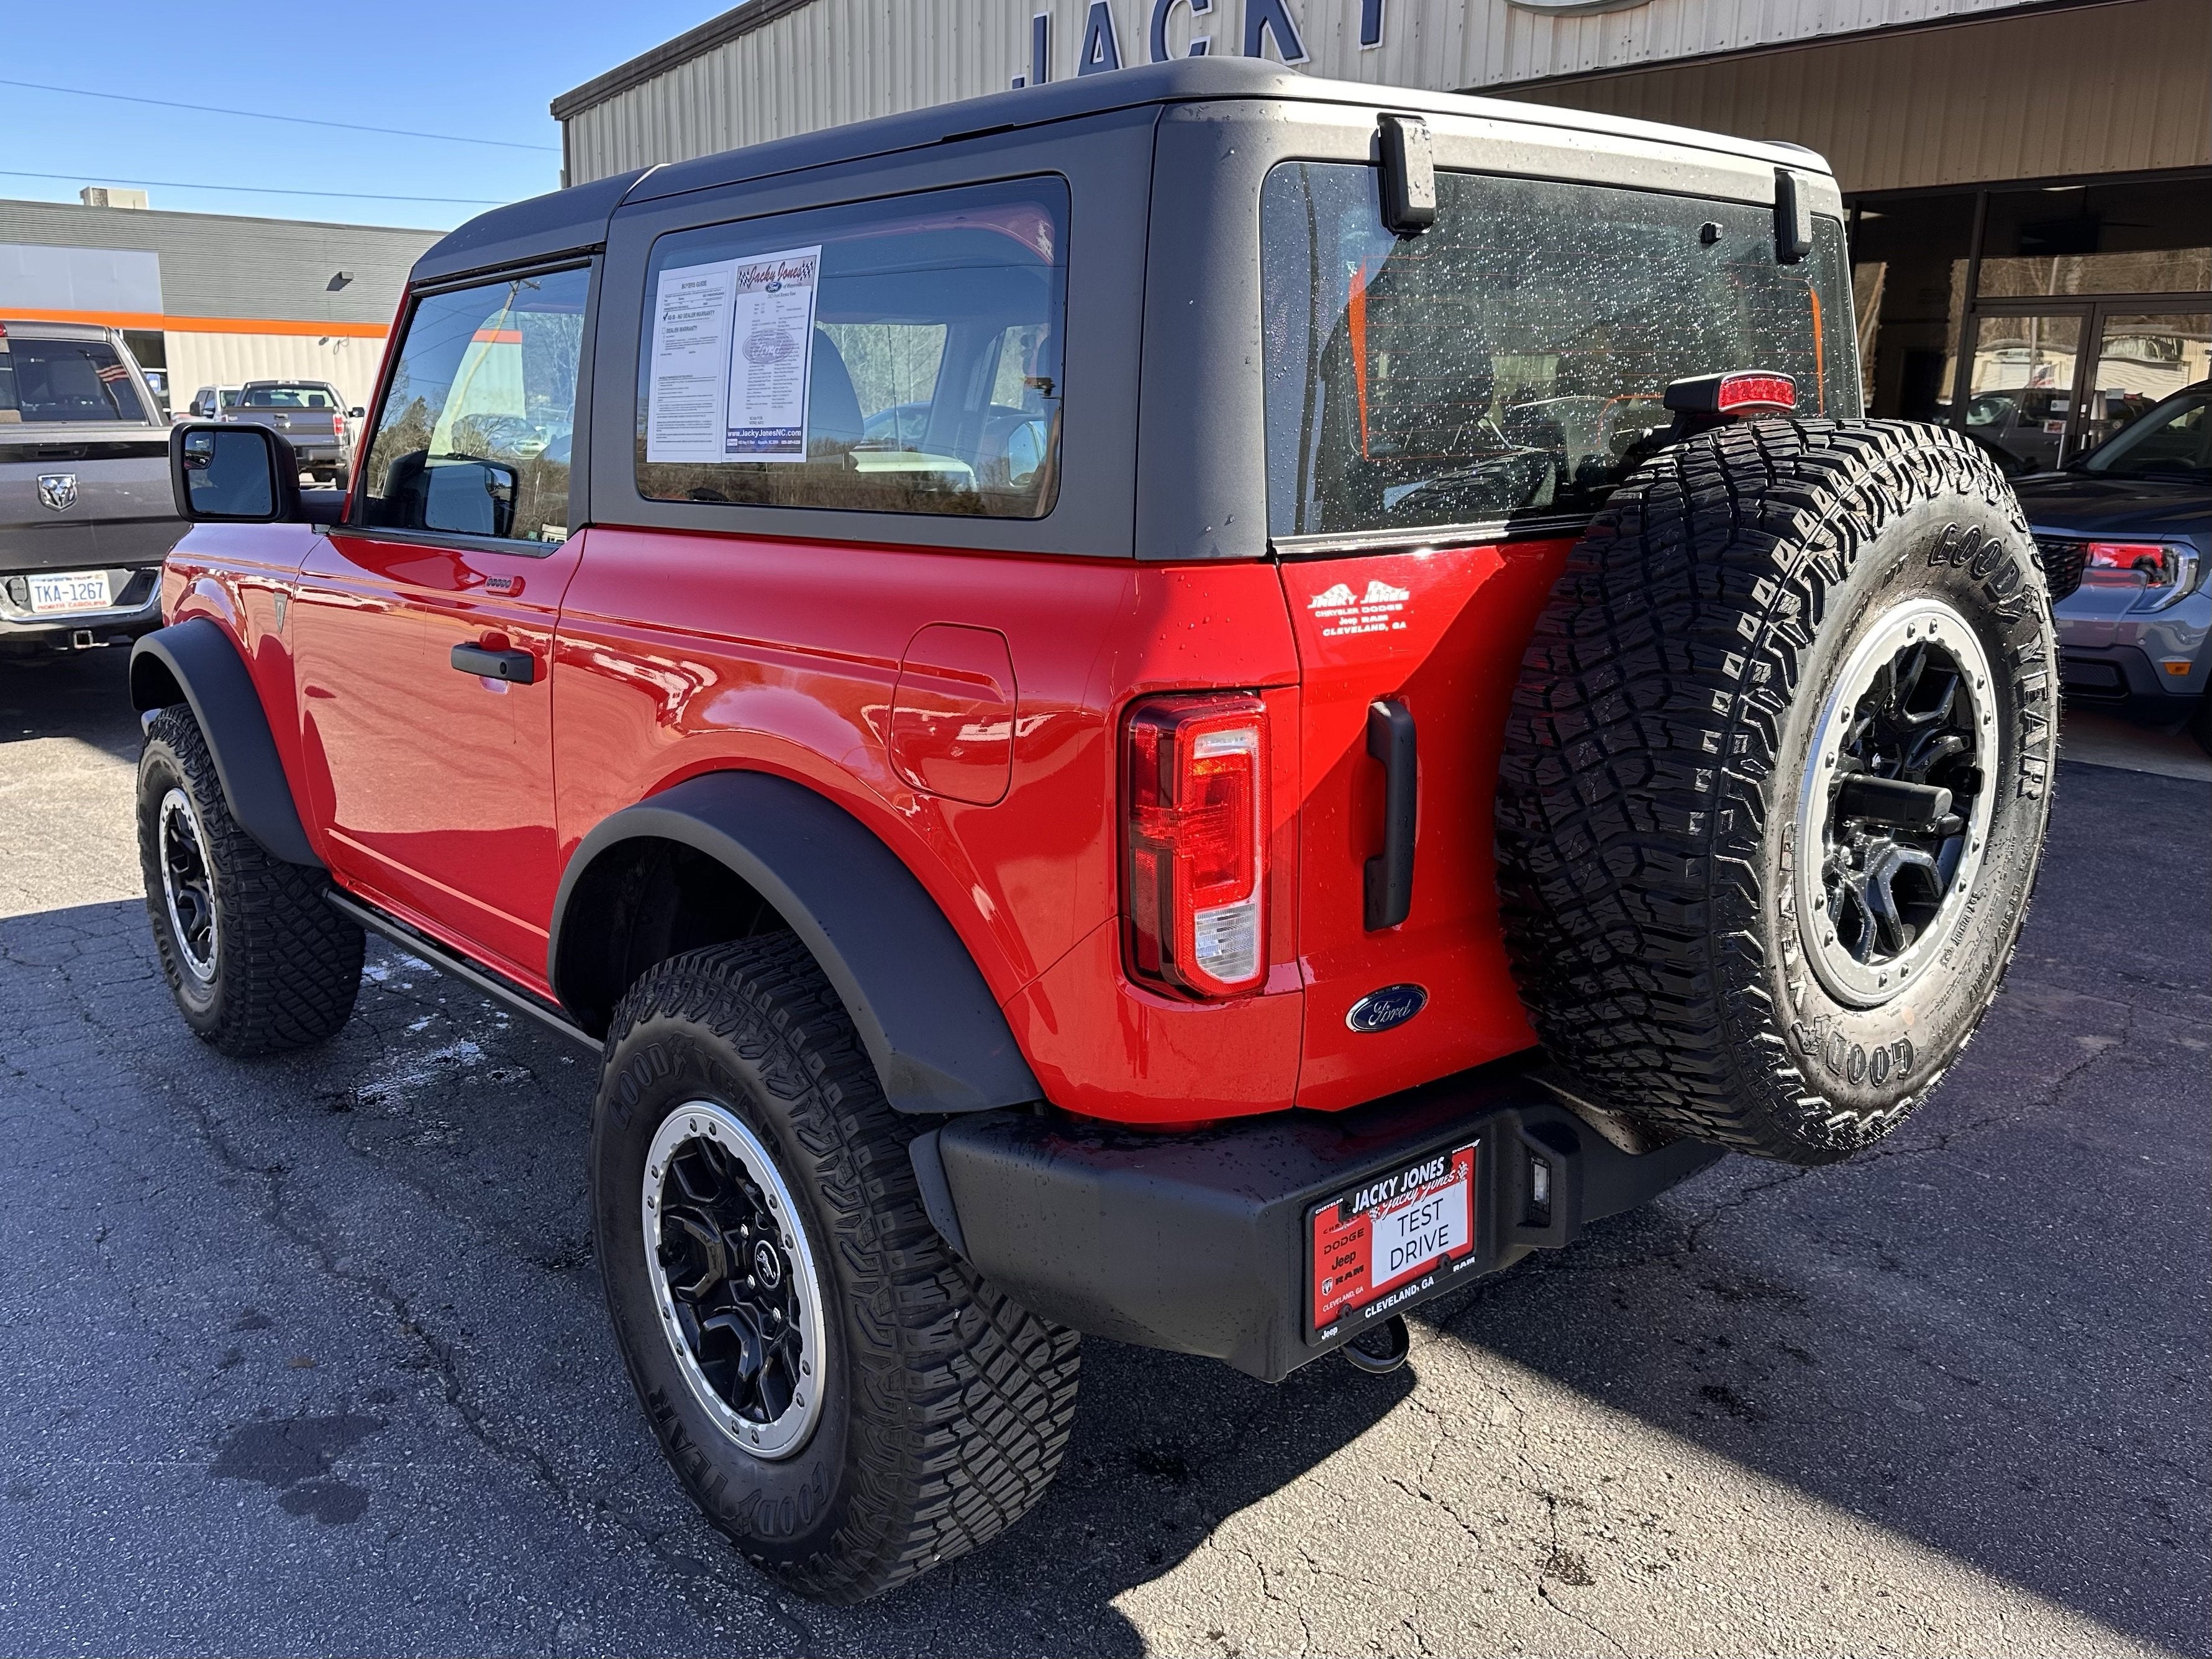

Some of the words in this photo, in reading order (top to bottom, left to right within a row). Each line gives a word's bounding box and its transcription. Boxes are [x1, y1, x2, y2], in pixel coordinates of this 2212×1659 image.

[747, 264, 775, 289] Jacky
[777, 261, 801, 281] Jones
[727, 429, 801, 438] www.JackyJonesNC.com
[35, 583, 103, 602] TKA-1267
[1307, 595, 1358, 609] JACKY
[68, 600, 107, 608] CAROLINA
[1315, 607, 1359, 617] CHRYSLER
[1361, 603, 1403, 613] DODGE
[1322, 623, 1389, 637] CLEVELAND,
[1391, 621, 1407, 629] GA
[1339, 617, 1358, 625] Jeep
[1361, 614, 1389, 623] RAM
[1928, 521, 2049, 801] GOODYEAR
[1368, 998, 1412, 1025] Ford
[1352, 1176, 1398, 1214] JACKY
[1400, 1156, 1445, 1192] JONES
[1315, 1198, 1344, 1214] CHRYSLER
[1397, 1198, 1444, 1237] TEST
[1324, 1227, 1365, 1255] DODGE
[1390, 1224, 1449, 1271] DRIVE
[1332, 1250, 1357, 1270] Jeep
[1452, 1256, 1475, 1273] RAM
[1335, 1265, 1365, 1285] RAM
[1322, 1290, 1355, 1312] CLEVELAND,
[1355, 1285, 1364, 1296] GA
[1365, 1284, 1419, 1319] CLEVELAND,
[1421, 1276, 1434, 1289] GA
[1321, 1326, 1338, 1340] Jeep
